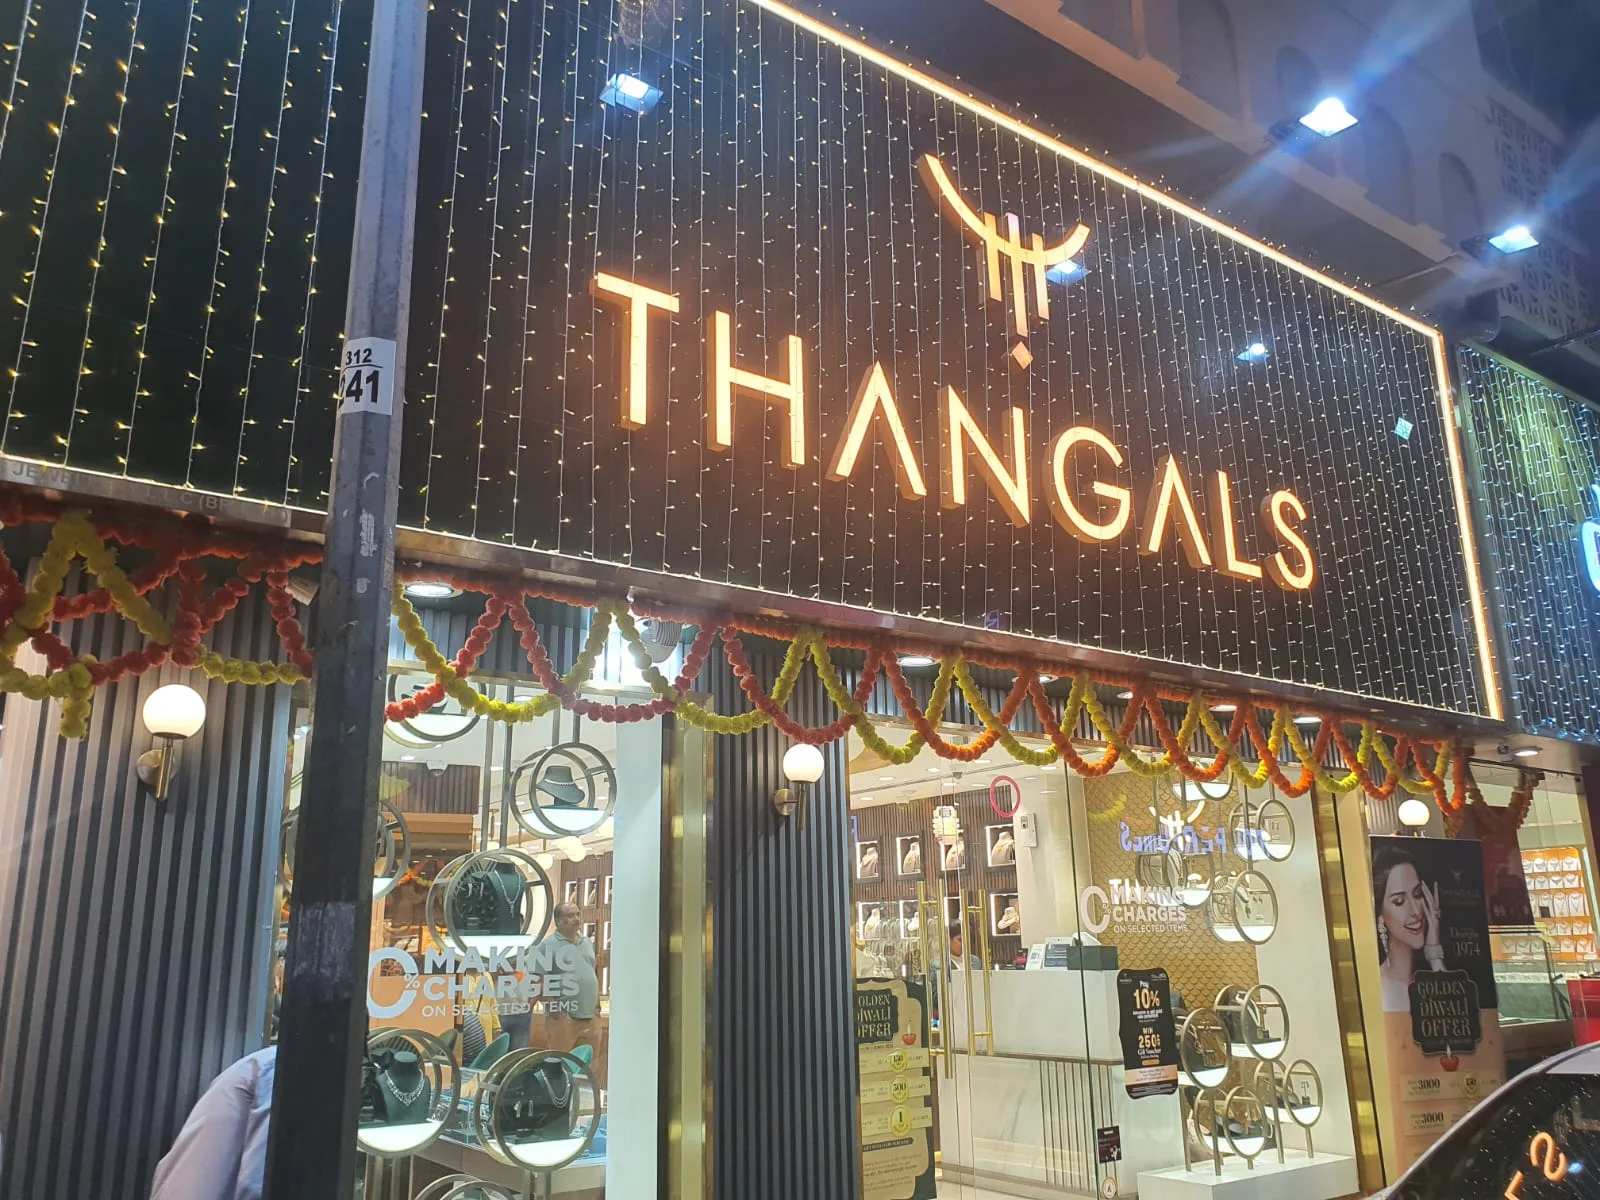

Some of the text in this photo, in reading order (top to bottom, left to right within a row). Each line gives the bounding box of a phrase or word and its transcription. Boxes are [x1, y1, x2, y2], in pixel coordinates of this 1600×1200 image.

[345, 348, 372, 365] 312
[592, 272, 1315, 591] THANGALS
[1110, 886, 1184, 905] MAKING
[1112, 906, 1187, 922] CHARGES
[1114, 923, 1188, 933] ON SELECTED ITEMS
[423, 945, 576, 974] MAKING
[423, 974, 580, 1000] CHARGES
[1417, 980, 1466, 998] GOLDEN
[858, 994, 890, 1007] OLDEN
[1133, 988, 1161, 1009] 10%
[1420, 997, 1469, 1017] DIWALI
[422, 1000, 579, 1018] ON SELECTED ITEMS
[1421, 1017, 1472, 1037] OFFER
